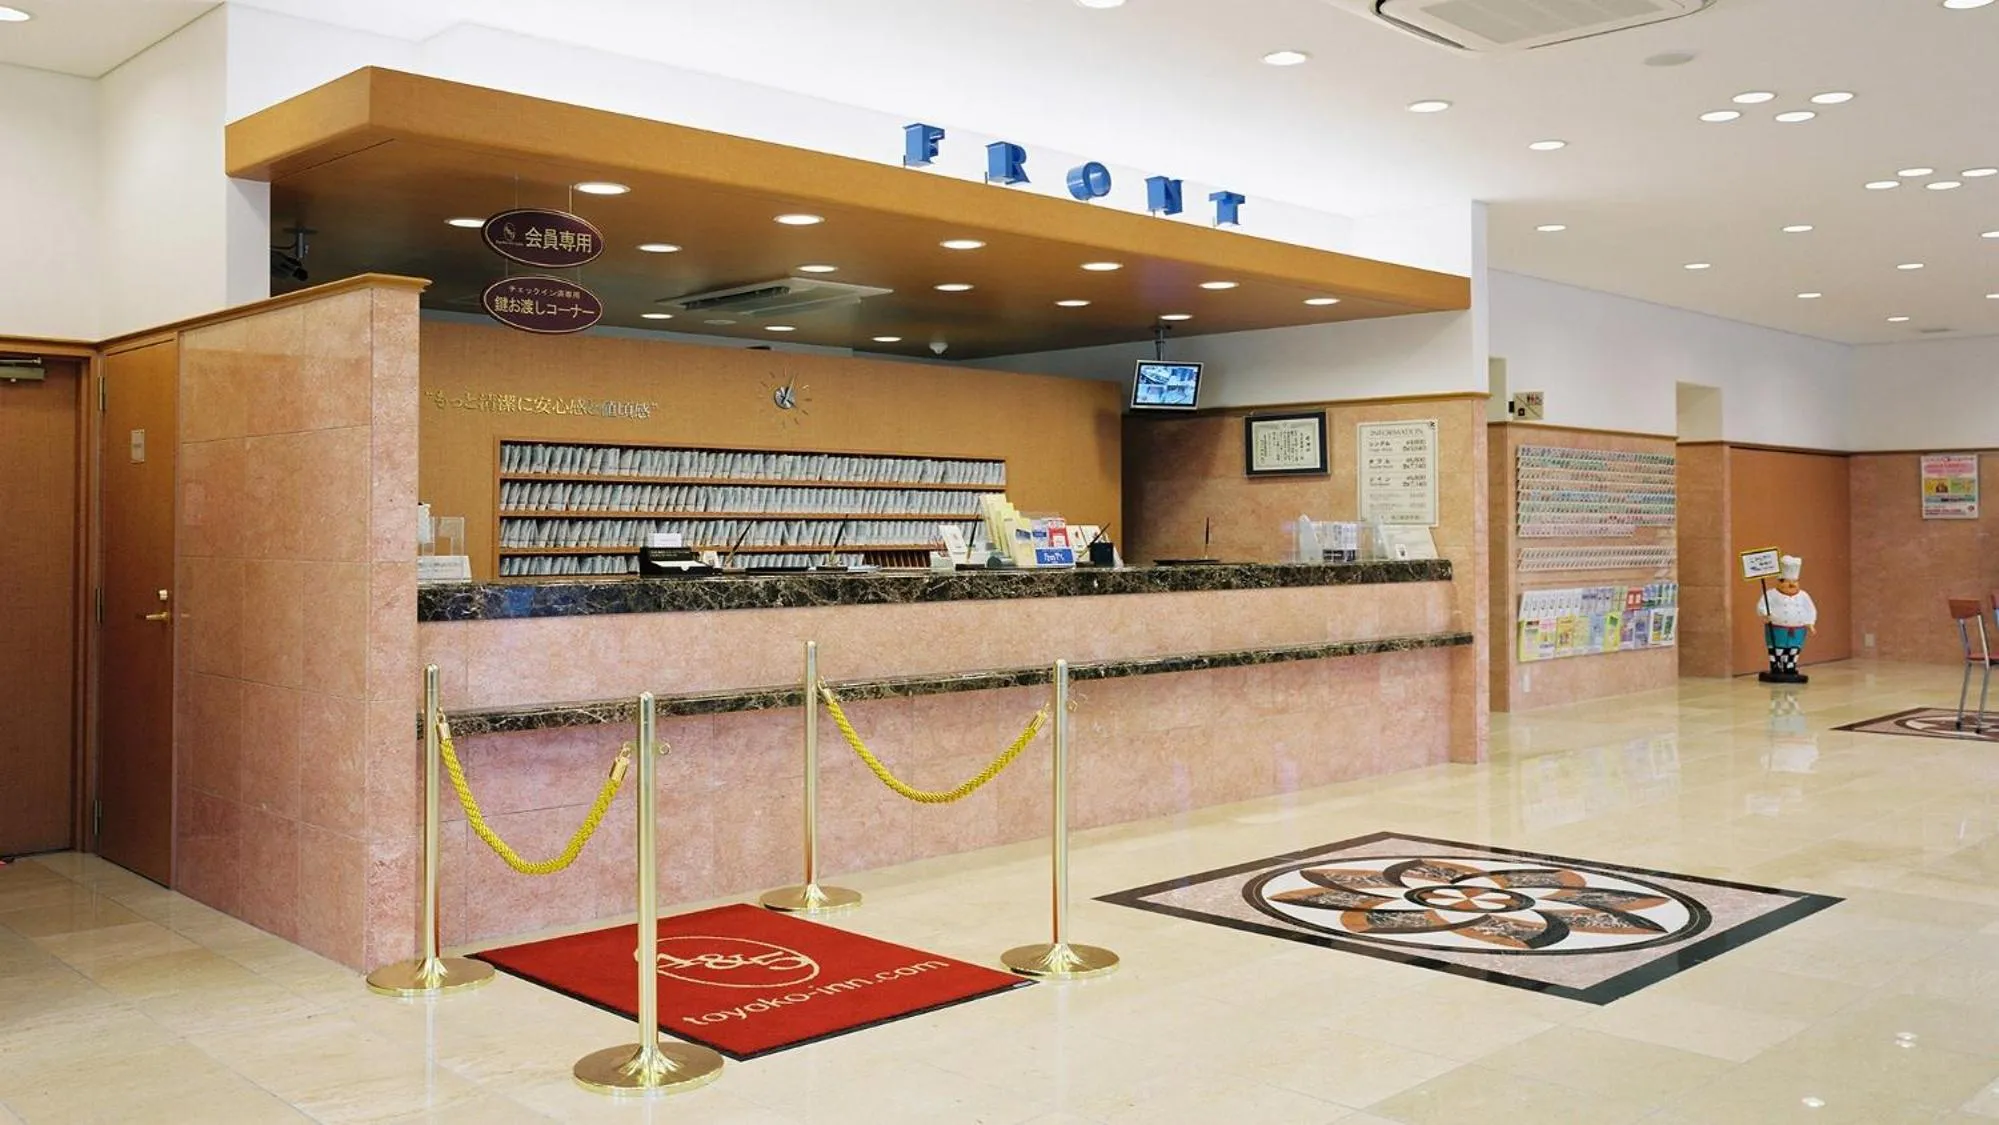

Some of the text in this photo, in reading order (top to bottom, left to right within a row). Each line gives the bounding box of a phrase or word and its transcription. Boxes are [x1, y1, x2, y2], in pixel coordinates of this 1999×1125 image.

[903, 123, 1246, 227] FRONT
[525, 226, 592, 253] 会員専用
[494, 296, 595, 318] 鍵お渡しコーナー
[682, 959, 949, 1027] toyoko-inn.com
